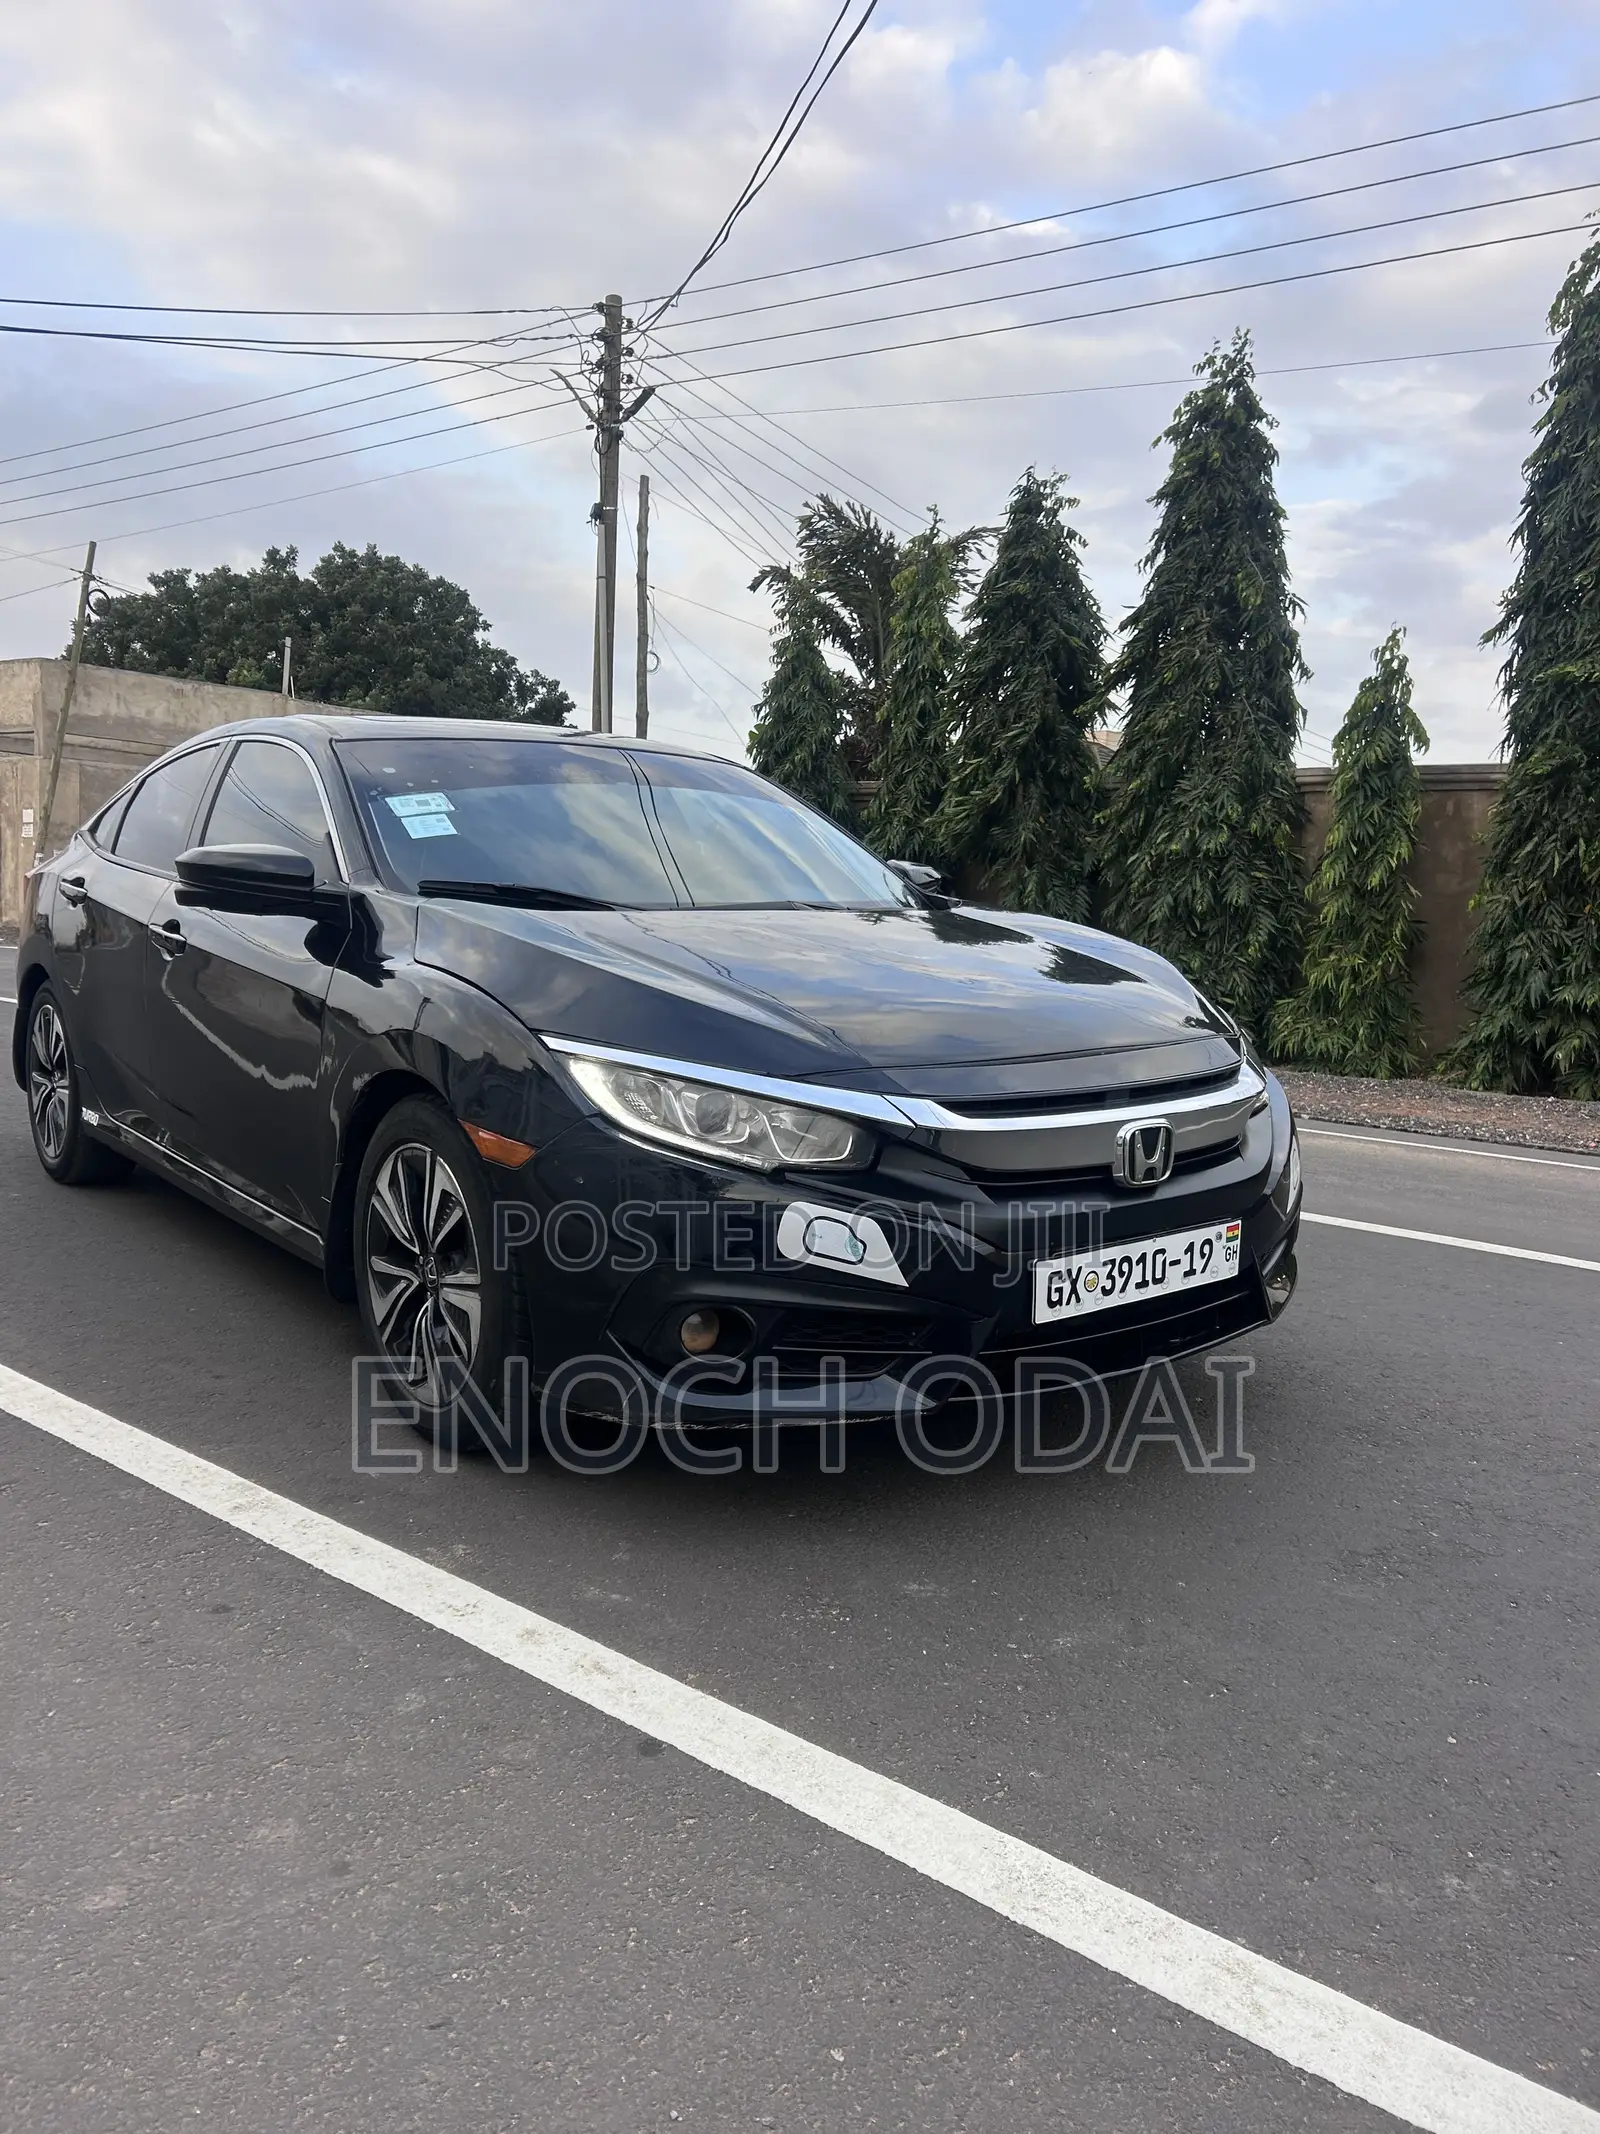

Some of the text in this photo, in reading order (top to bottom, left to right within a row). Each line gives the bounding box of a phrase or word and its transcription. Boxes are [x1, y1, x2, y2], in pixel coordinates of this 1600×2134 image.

[1046, 1238, 1214, 1309] GX 3910-19
[1225, 1244, 1238, 1262] GH
